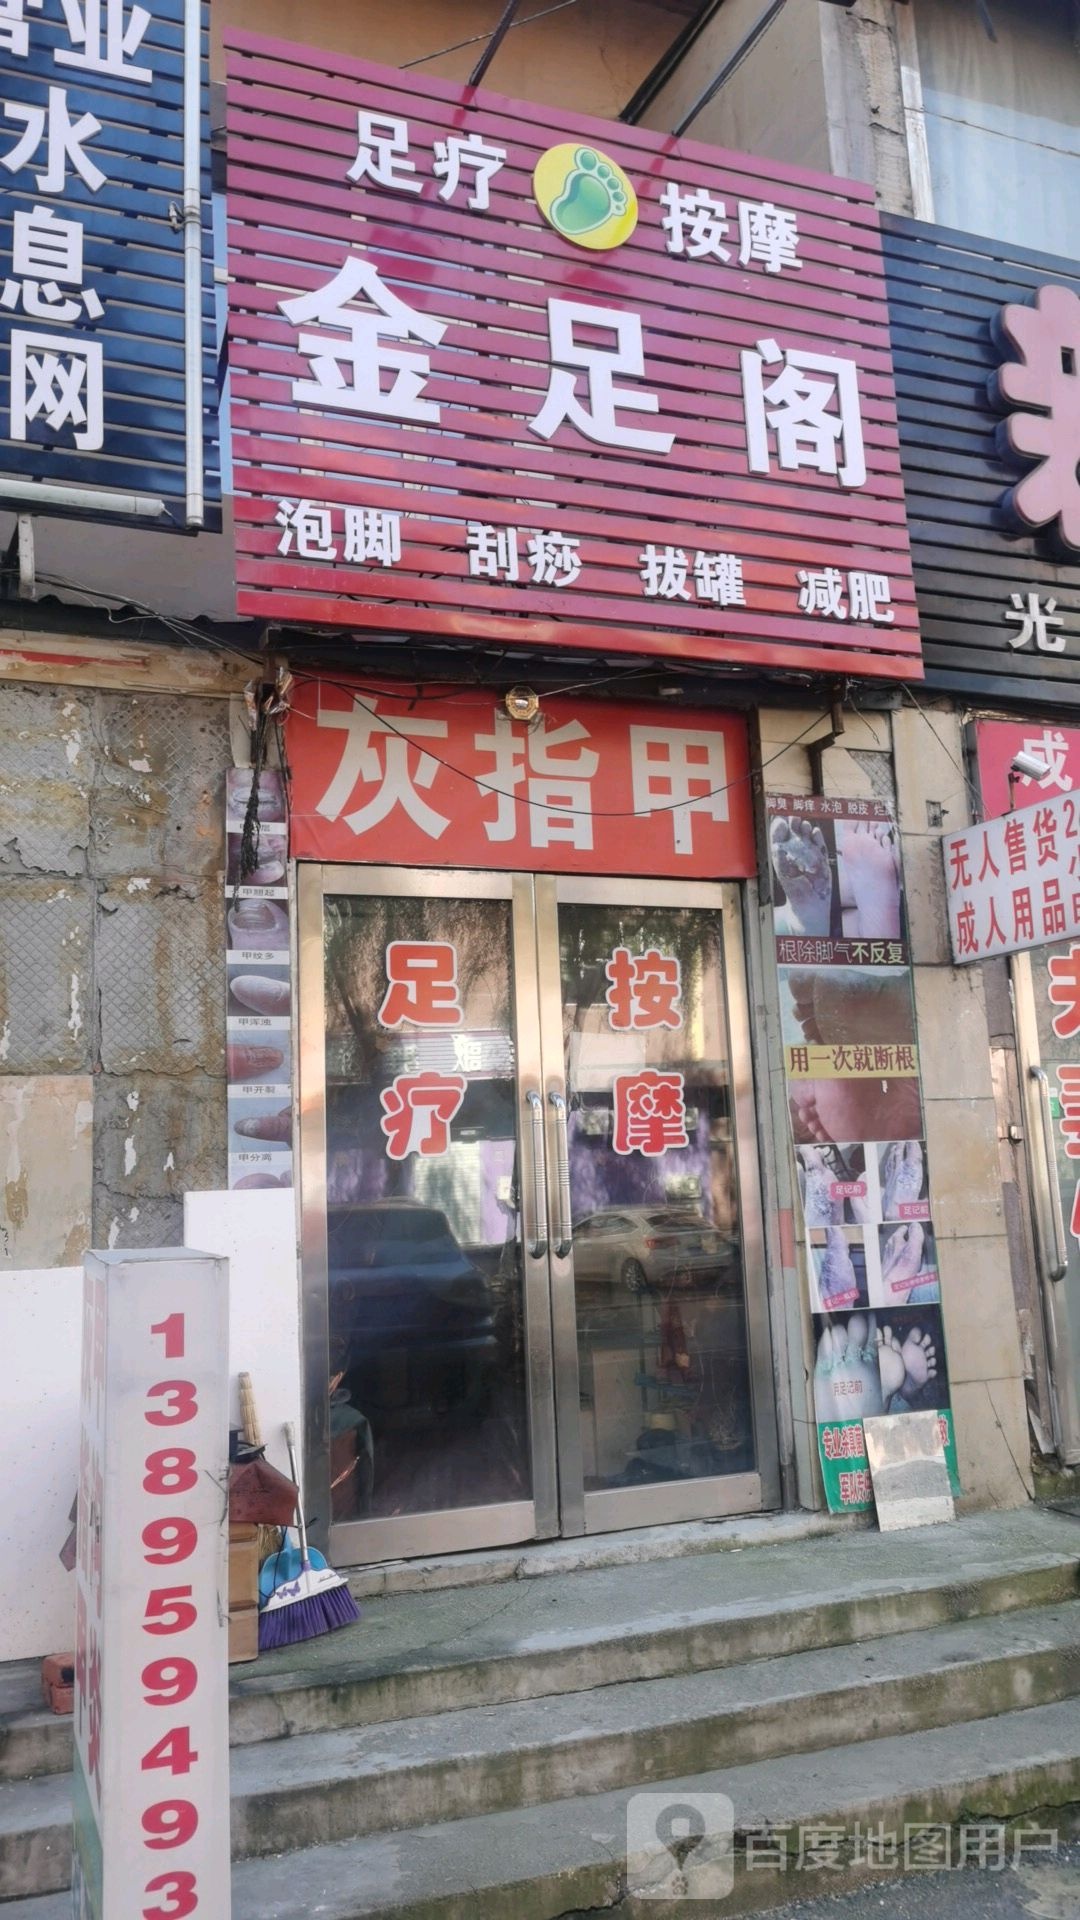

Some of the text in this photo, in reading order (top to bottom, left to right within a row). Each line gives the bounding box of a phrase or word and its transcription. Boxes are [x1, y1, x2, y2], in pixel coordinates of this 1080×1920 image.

[347, 110, 803, 273] 足疗 按摩
[278, 256, 867, 488] 金足阁
[276, 498, 895, 623] 泡脚 刮痧 拔罐 减肥
[1005, 592, 1067, 653] 光
[315, 693, 730, 856] 灰指甲
[821, 801, 842, 814] 水泡
[847, 802, 869, 815] 脱皮
[1021, 730, 1073, 793] 成
[790, 1045, 916, 1073] 用一次就断根
